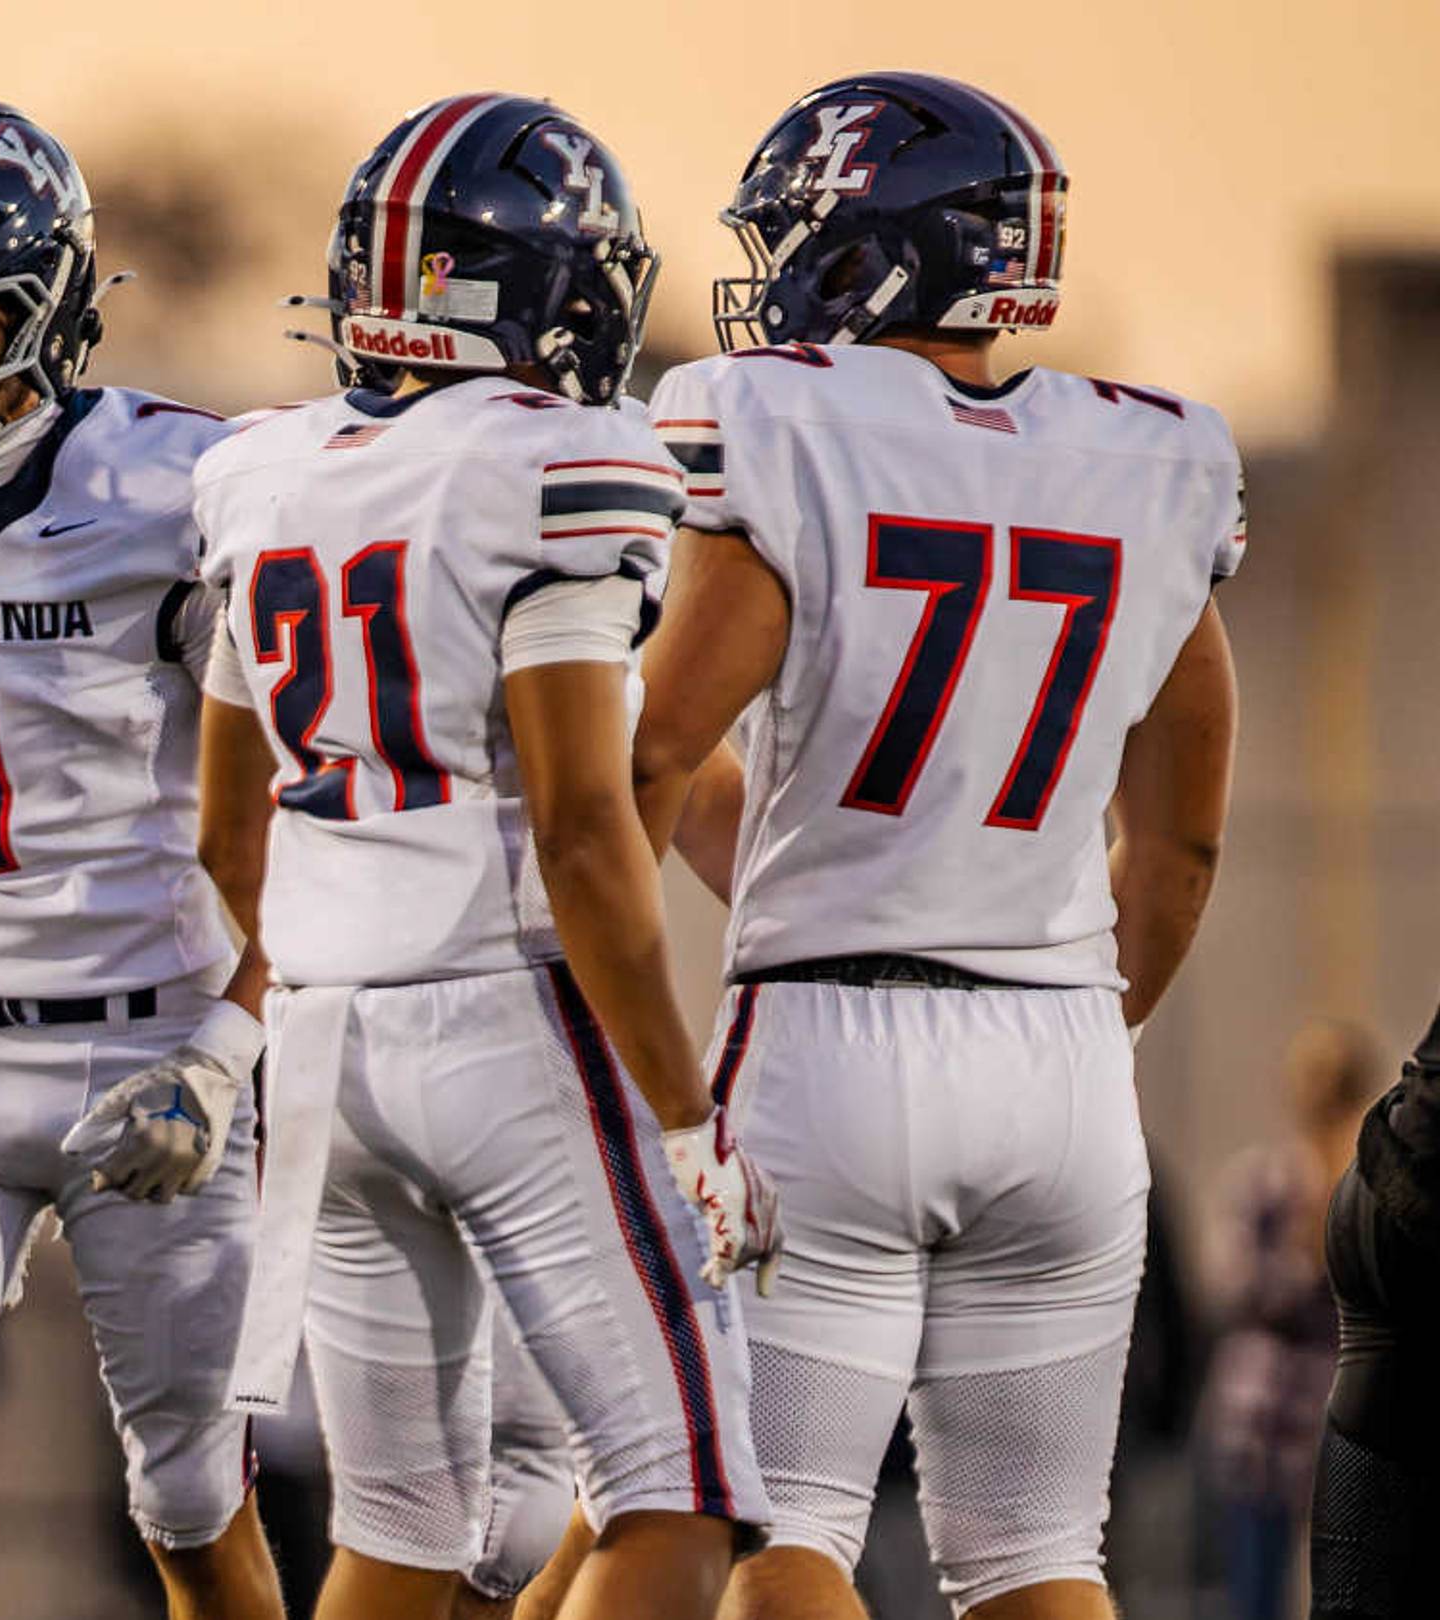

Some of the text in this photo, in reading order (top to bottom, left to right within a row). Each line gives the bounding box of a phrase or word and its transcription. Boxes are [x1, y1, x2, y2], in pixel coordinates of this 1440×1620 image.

[350, 322, 457, 361] Riddell
[987, 298, 1060, 325] Ridd
[251, 539, 453, 821] 21
[839, 512, 1123, 832] 77
